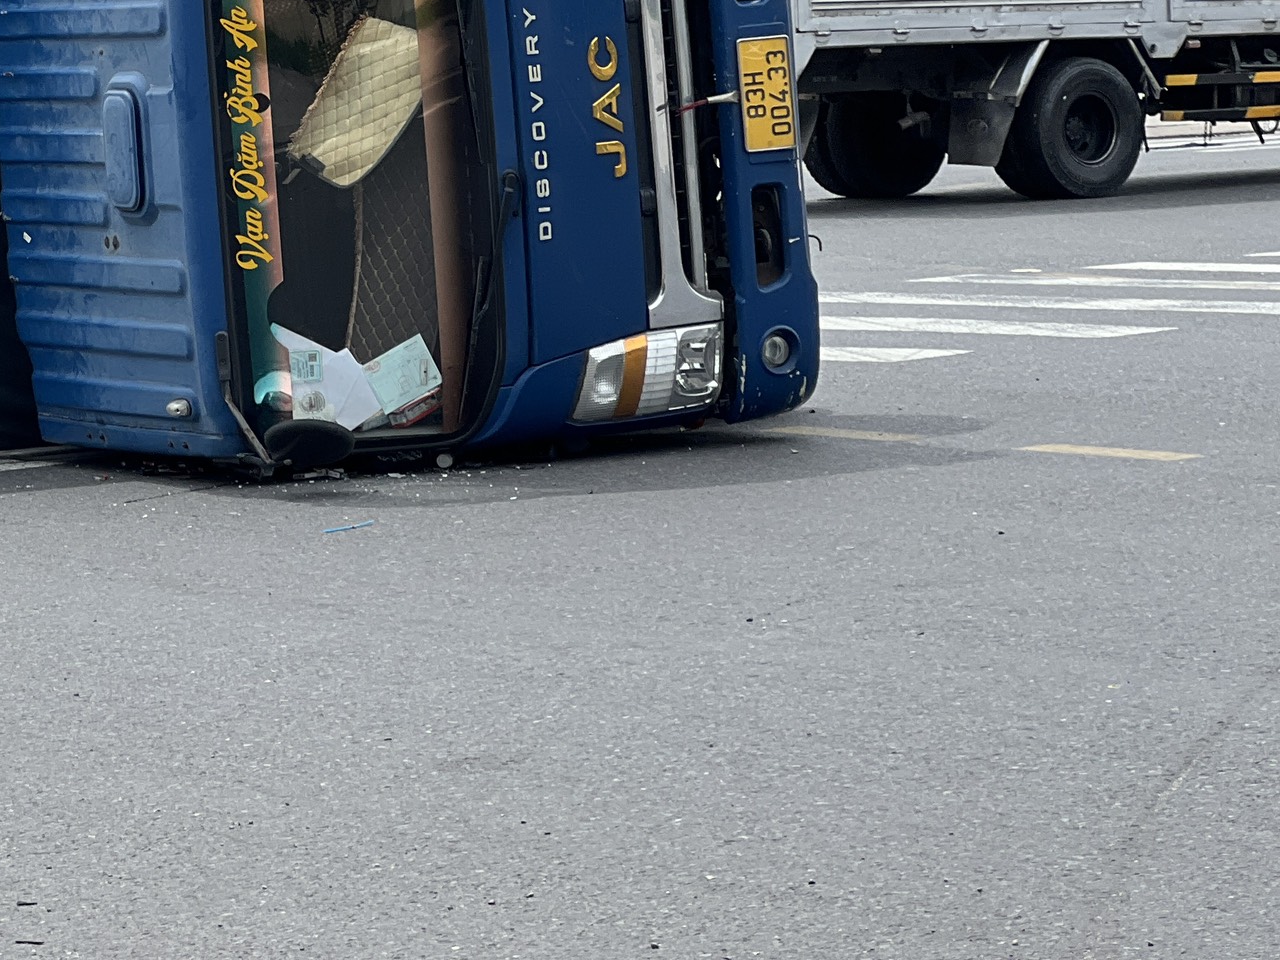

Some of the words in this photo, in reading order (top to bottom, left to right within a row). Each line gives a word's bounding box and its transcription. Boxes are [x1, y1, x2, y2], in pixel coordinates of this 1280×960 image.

[220, 5, 259, 53] An
[223, 55, 264, 128] Bình
[523, 7, 552, 241] DISCOVERY
[587, 35, 627, 178] JAC
[743, 72, 767, 119] 83H
[765, 50, 792, 136] 004.33
[229, 131, 269, 205] Dặm
[235, 206, 274, 271] Vạn
